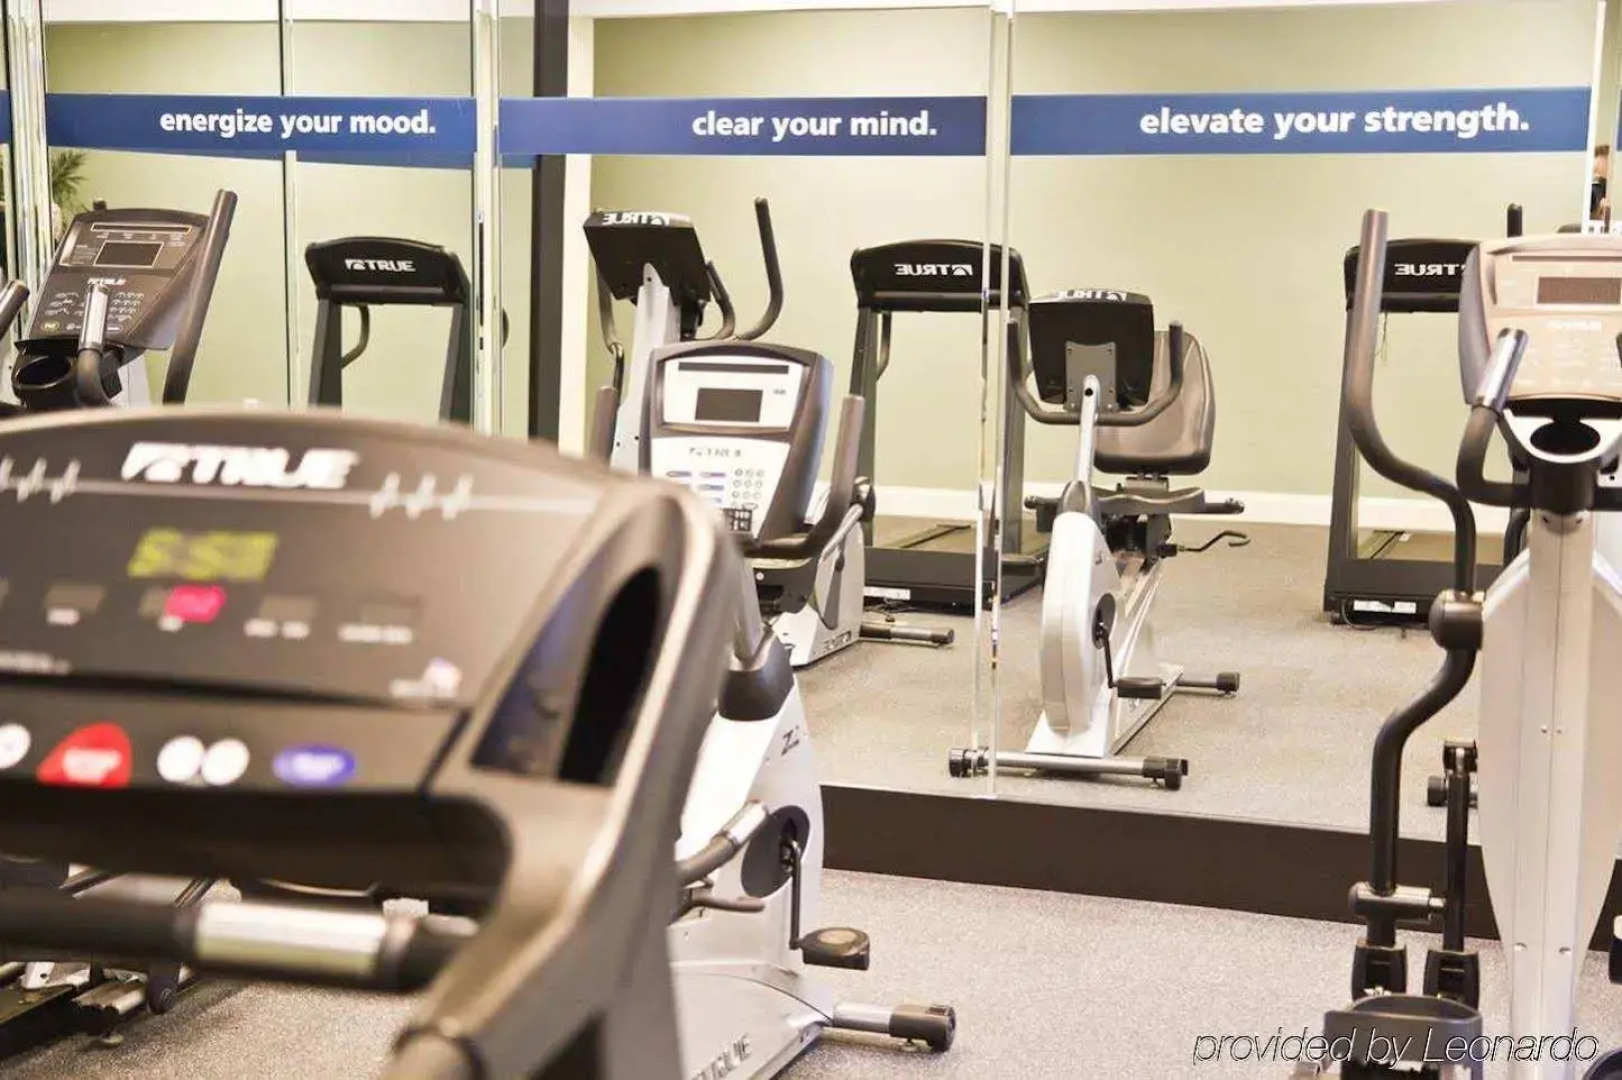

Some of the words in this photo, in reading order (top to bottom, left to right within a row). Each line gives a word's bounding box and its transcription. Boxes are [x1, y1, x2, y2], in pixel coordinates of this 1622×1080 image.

[160, 108, 273, 138] energize
[280, 114, 343, 139] your
[349, 108, 436, 135] mood.
[692, 110, 764, 136] clear
[771, 117, 842, 142] your
[850, 110, 937, 136] mind.
[1139, 107, 1265, 134] elevate
[1273, 111, 1356, 140] your
[1364, 102, 1530, 139] strength.
[366, 259, 416, 272] TRUE
